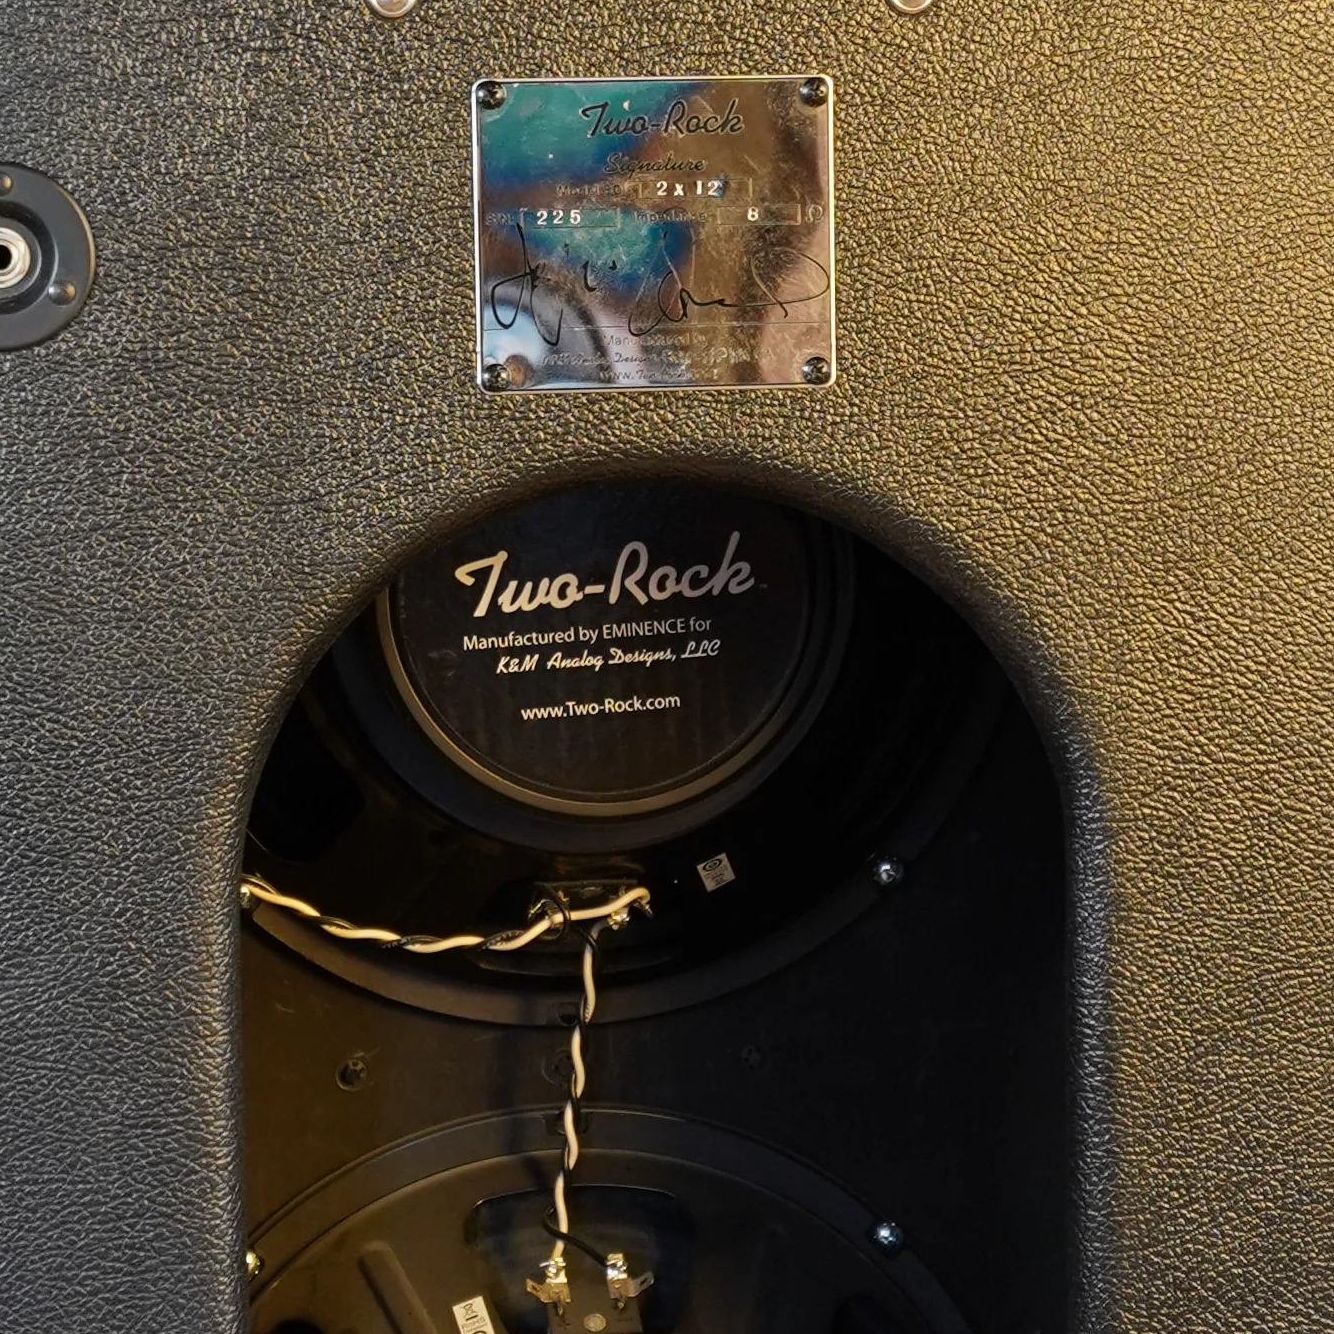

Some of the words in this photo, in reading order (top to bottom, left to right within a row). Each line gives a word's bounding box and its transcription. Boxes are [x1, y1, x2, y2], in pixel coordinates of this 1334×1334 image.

[580, 98, 745, 138] Two-Rock
[604, 151, 705, 174] Signature
[536, 210, 582, 225] 225
[747, 206, 759, 222] 8
[455, 531, 755, 618] Two-Rock
[463, 626, 574, 651] Manufactured
[579, 625, 599, 644] by
[603, 618, 686, 640] EMINENCE
[689, 616, 712, 633] for
[496, 654, 538, 675] K&M
[546, 649, 604, 672] Analog
[608, 645, 677, 666] Designs,
[521, 694, 681, 720] www.Two-Rock.com
